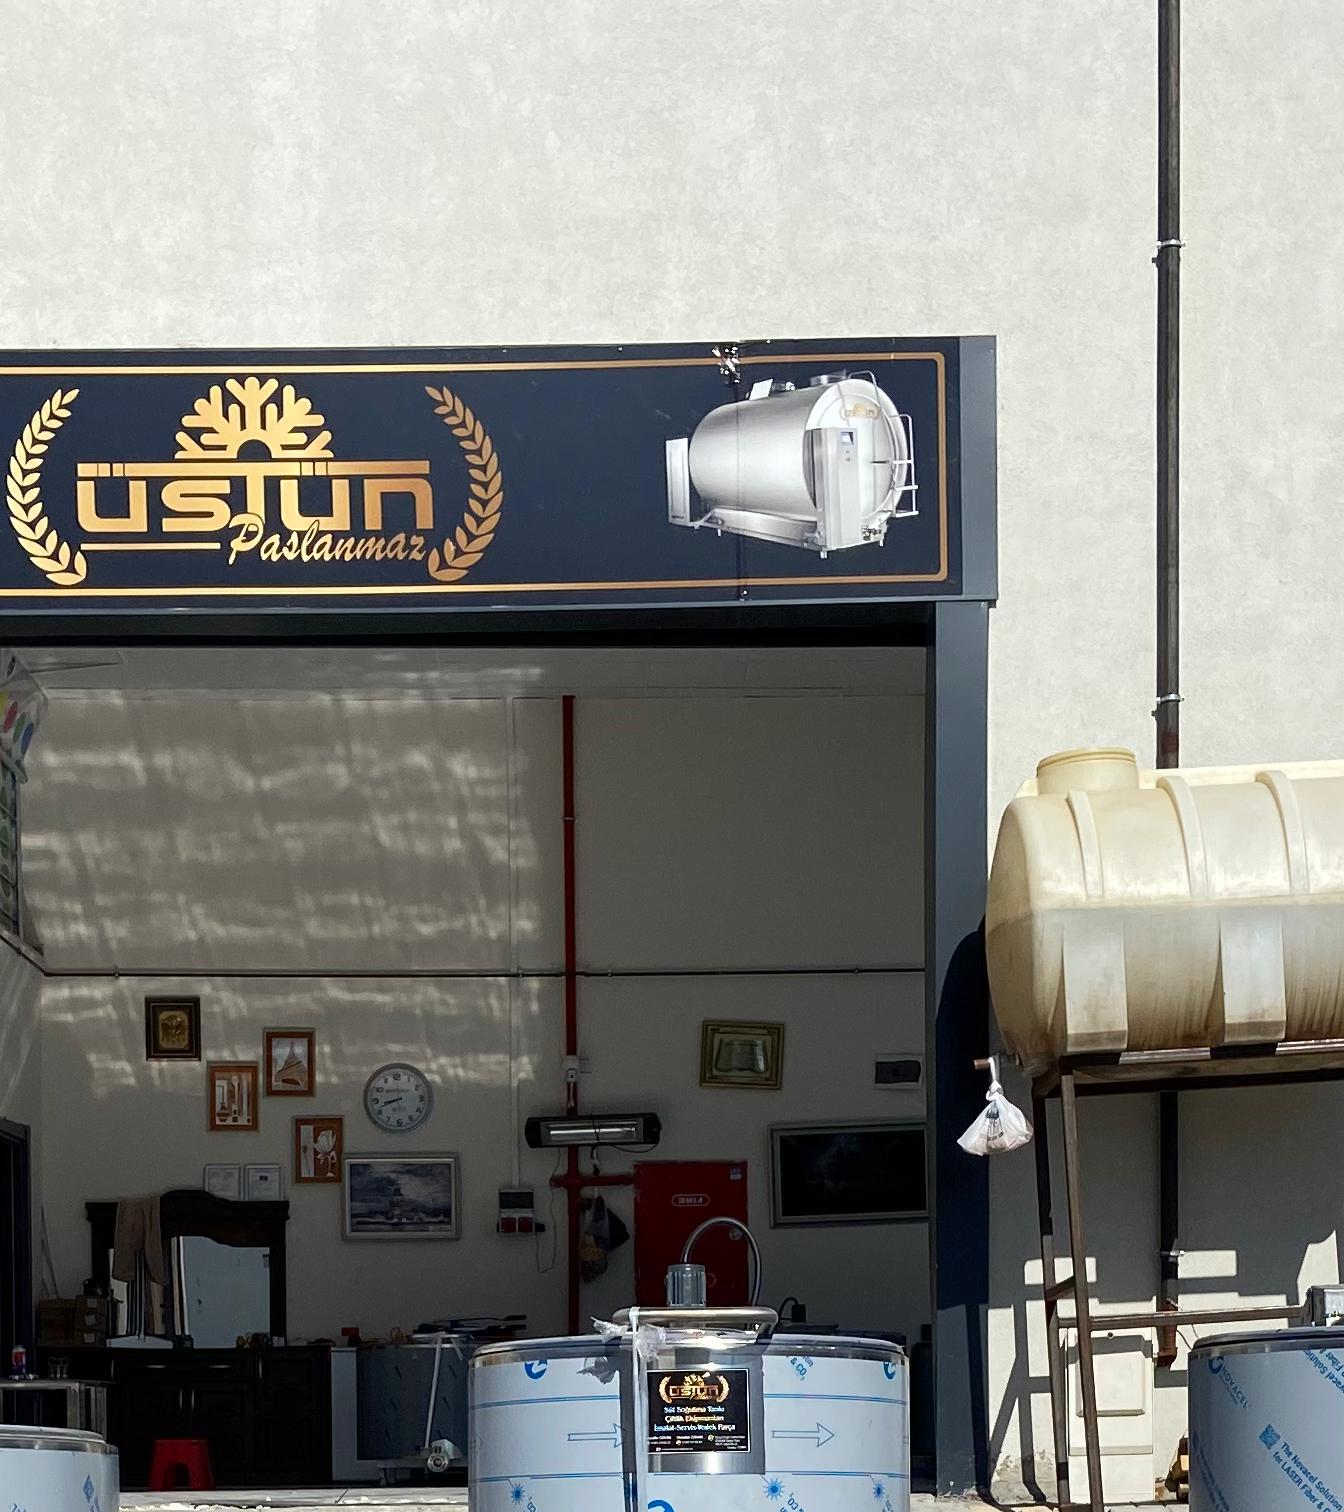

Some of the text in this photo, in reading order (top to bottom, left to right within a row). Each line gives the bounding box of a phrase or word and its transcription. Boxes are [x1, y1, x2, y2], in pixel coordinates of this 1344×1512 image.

[228, 513, 427, 564] Paslanmaz
[1272, 1451, 1284, 1465] for
[1281, 1461, 1303, 1487] LASER
[1301, 1485, 1317, 1504] Fiber
[1280, 1441, 1343, 1512] The Novacel Solution
